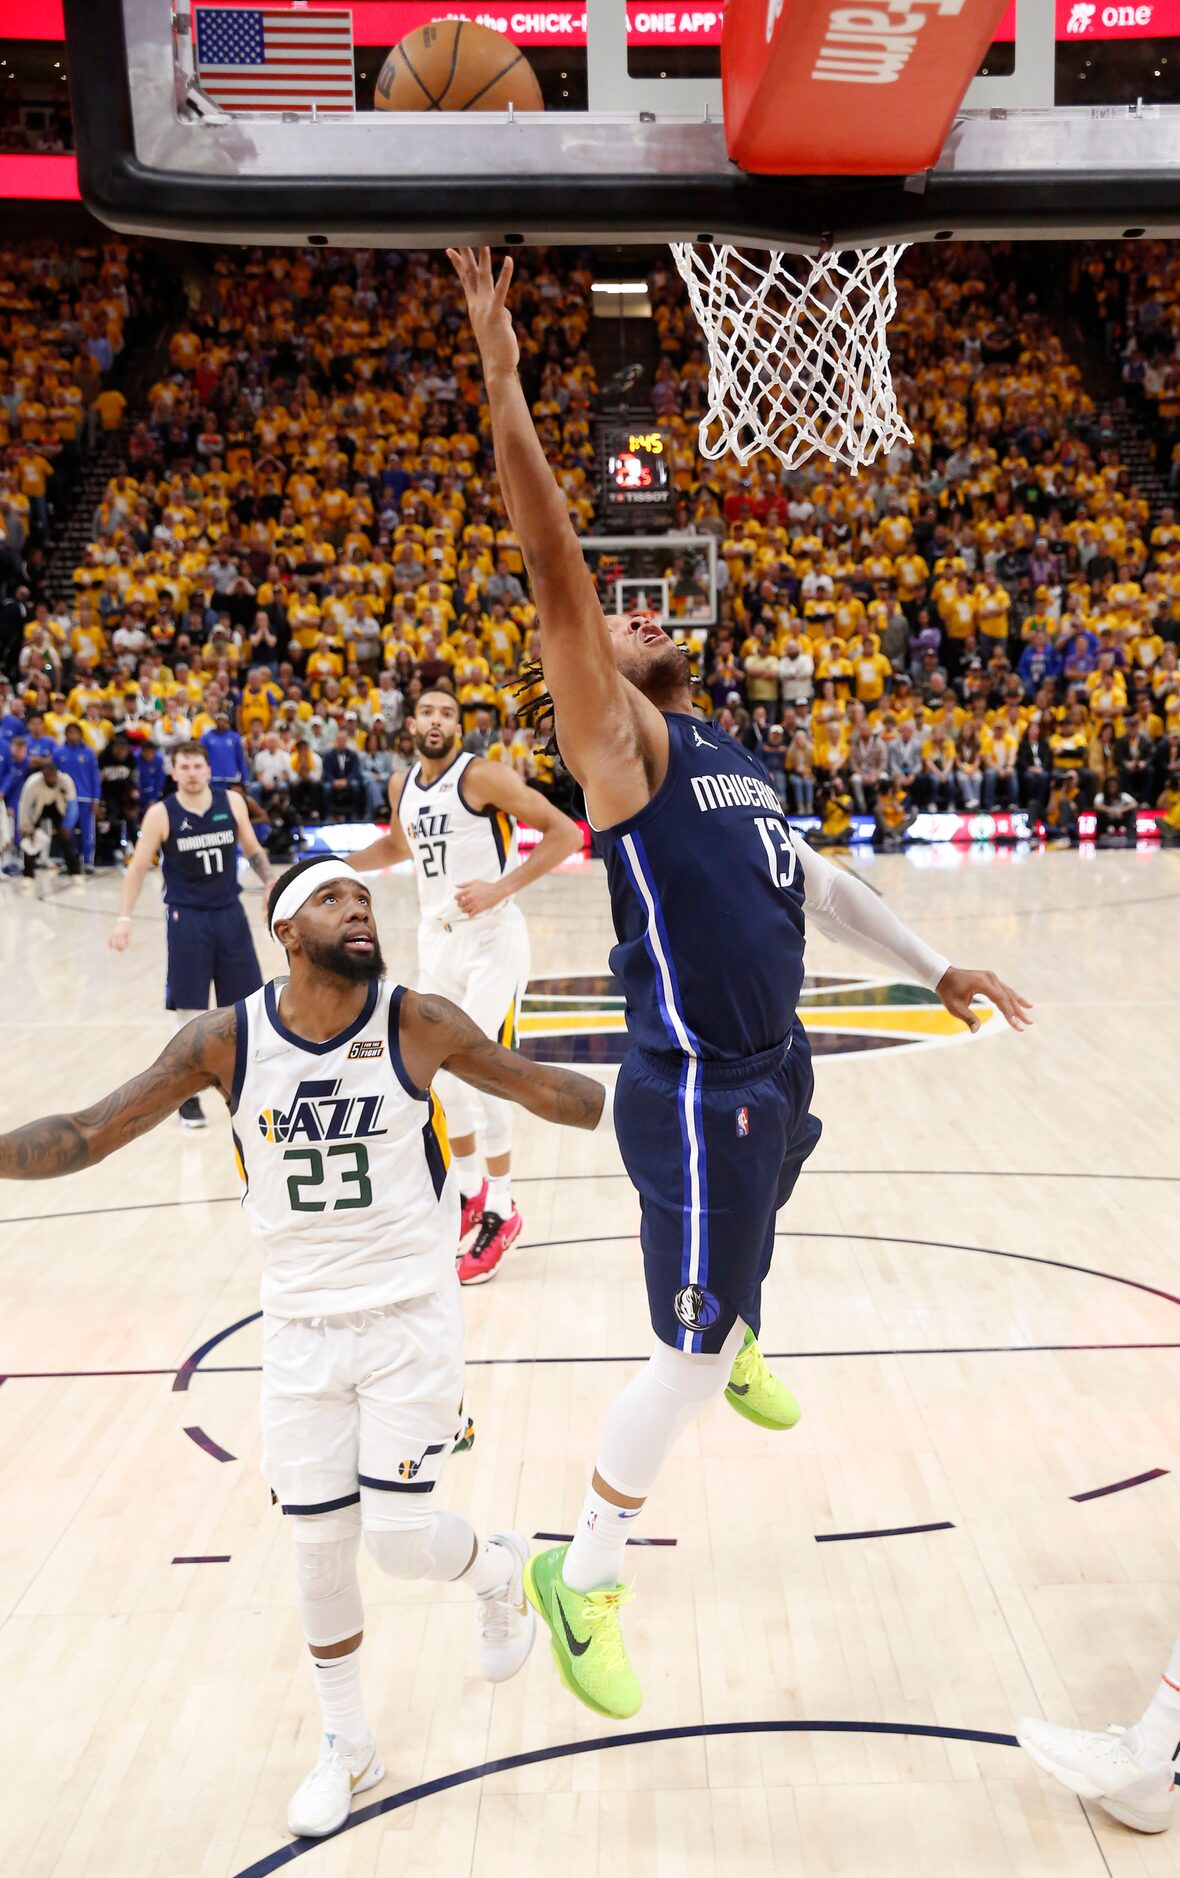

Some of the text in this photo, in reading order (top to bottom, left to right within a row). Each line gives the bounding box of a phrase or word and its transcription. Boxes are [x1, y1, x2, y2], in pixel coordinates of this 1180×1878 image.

[635, 13, 676, 33] ONE
[679, 12, 717, 33] APP
[1102, 5, 1151, 27] one
[629, 432, 663, 454] 1:45
[625, 491, 670, 502] TISSOT
[407, 806, 454, 842] JAZZ
[195, 847, 224, 876] 77
[418, 841, 447, 879] 27
[753, 817, 797, 888] 13
[350, 1043, 361, 1058] 5
[360, 1049, 383, 1057] FIGHT
[259, 1078, 389, 1144] JAZZ
[283, 1143, 373, 1212] 23
